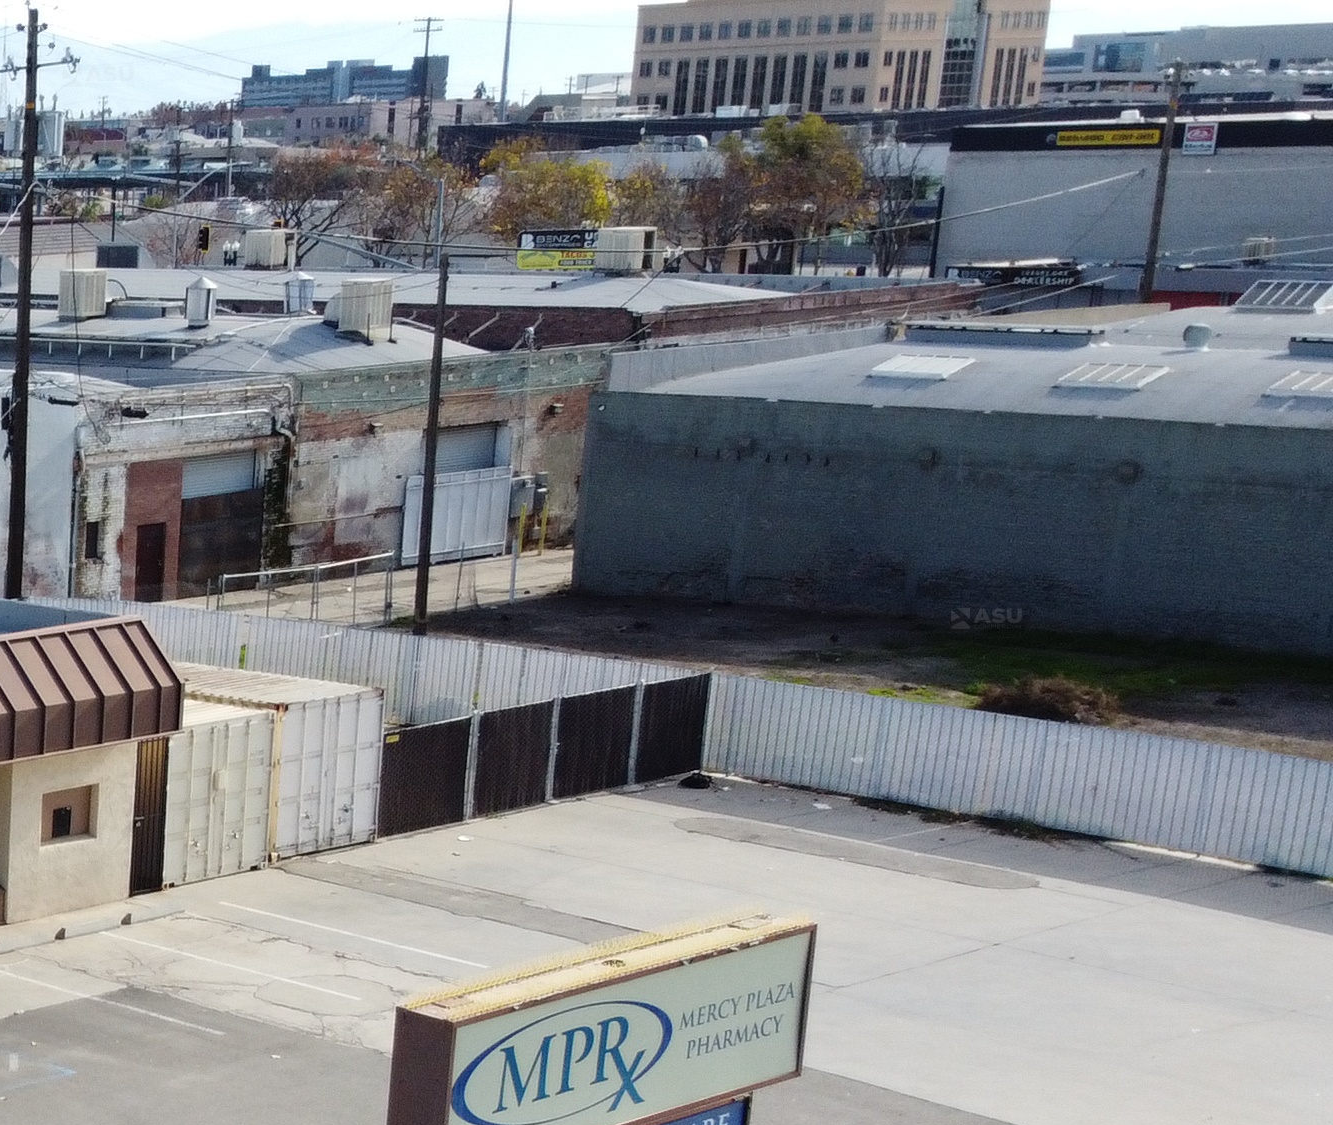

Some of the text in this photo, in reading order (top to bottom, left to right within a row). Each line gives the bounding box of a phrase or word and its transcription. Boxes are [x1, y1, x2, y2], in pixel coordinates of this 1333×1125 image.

[679, 982, 794, 1031] MERCY PLAZA
[686, 1014, 784, 1059] PHARMACY
